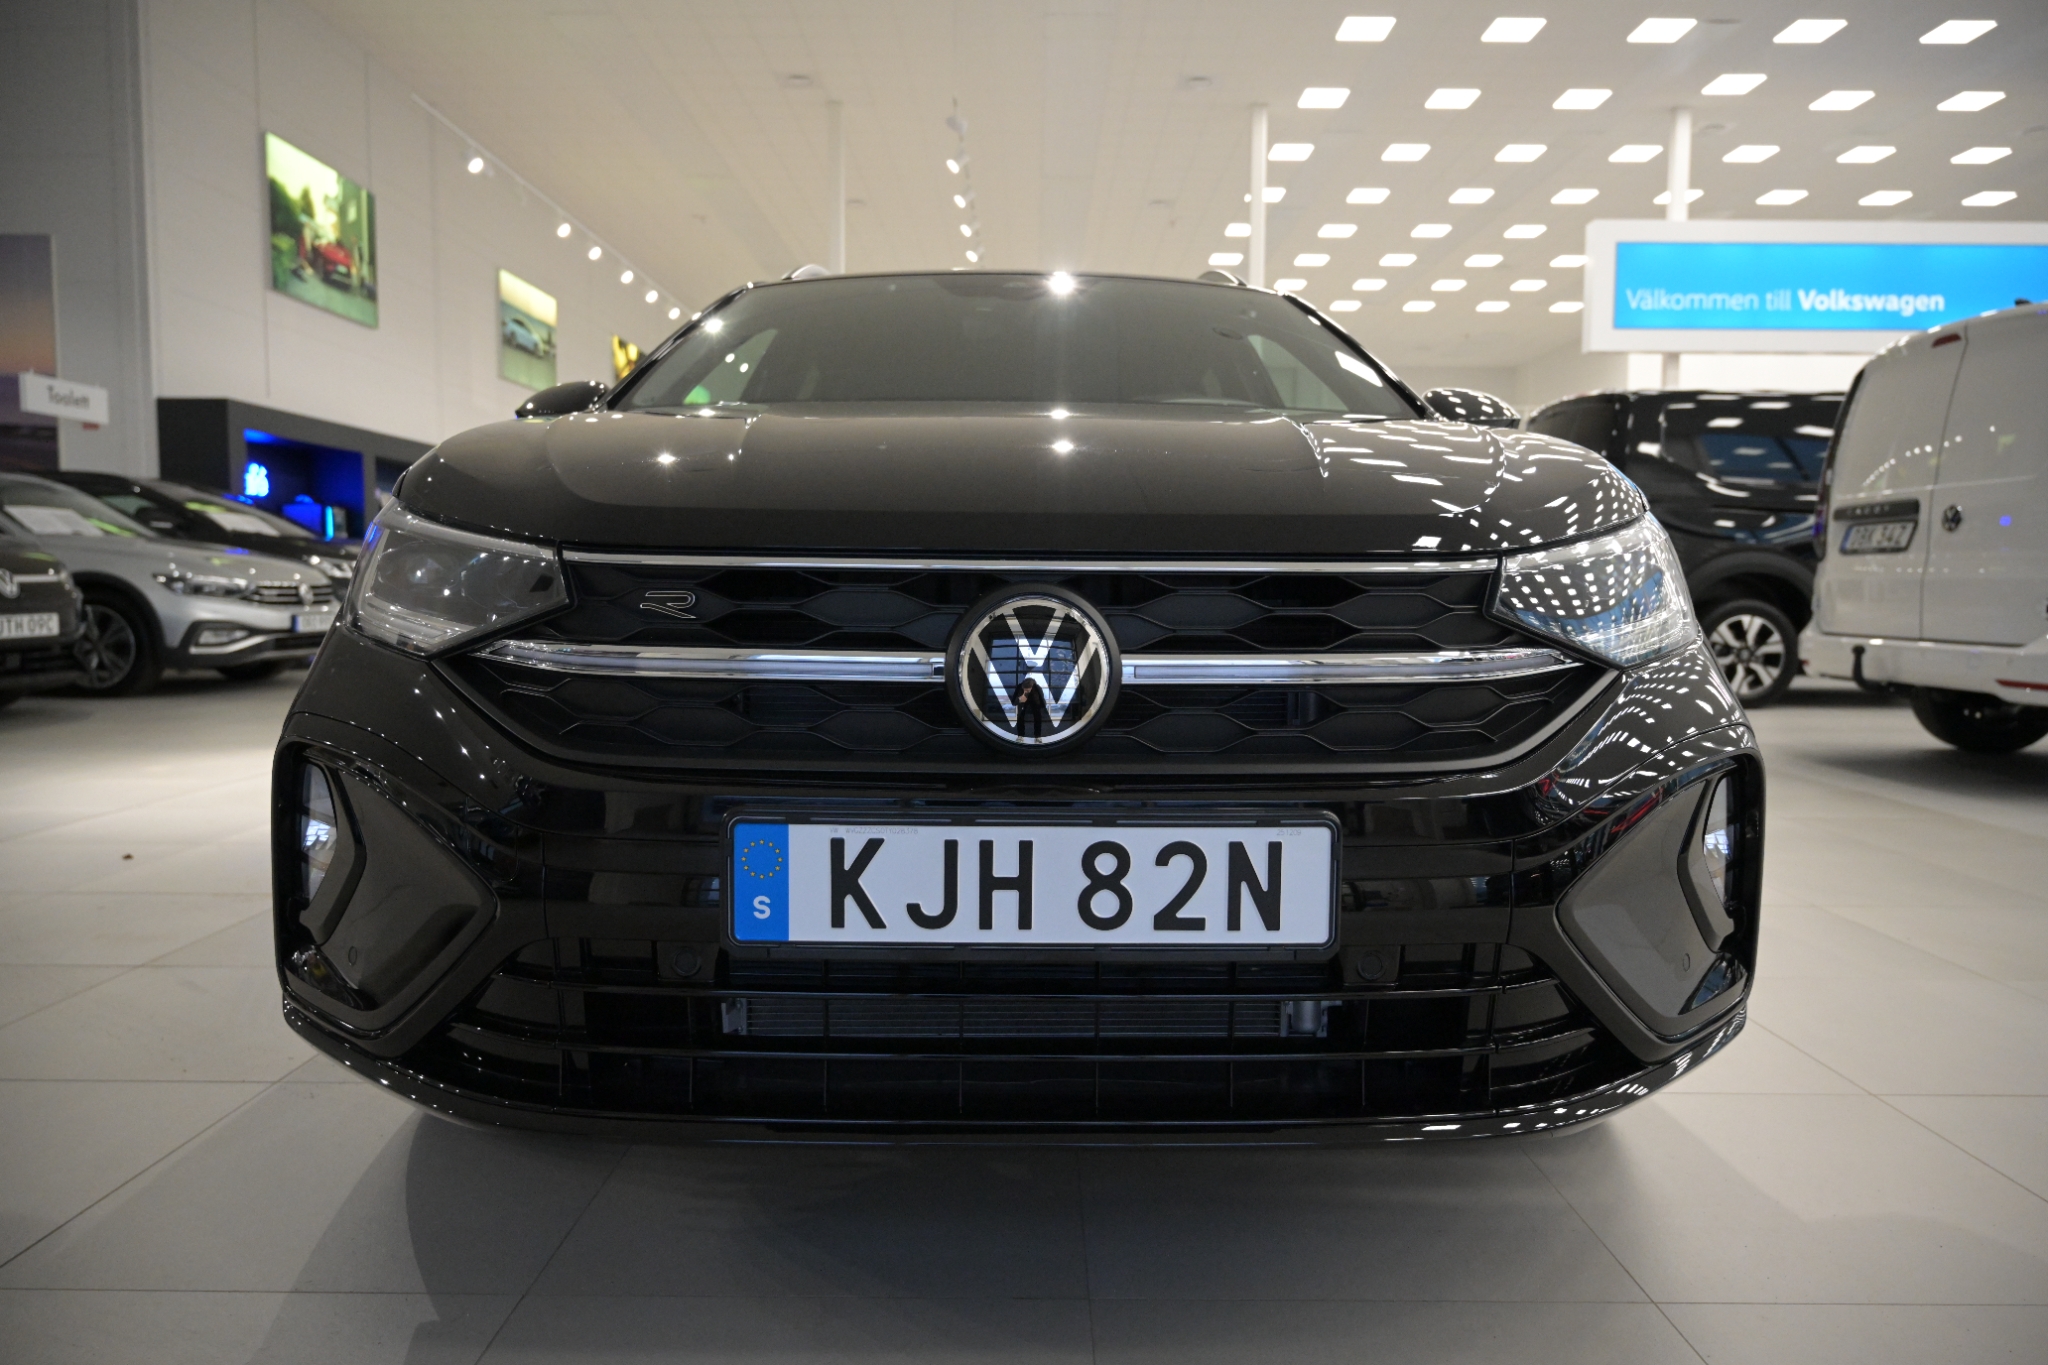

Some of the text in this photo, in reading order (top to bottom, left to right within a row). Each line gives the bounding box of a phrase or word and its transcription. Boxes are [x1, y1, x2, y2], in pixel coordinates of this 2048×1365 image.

[1625, 287, 1946, 317] Välkommen till Volkswagen
[46, 384, 90, 410] Toalett
[964, 598, 1106, 740] VW
[830, 837, 1283, 932] KJH 82N
[753, 895, 771, 920] S
